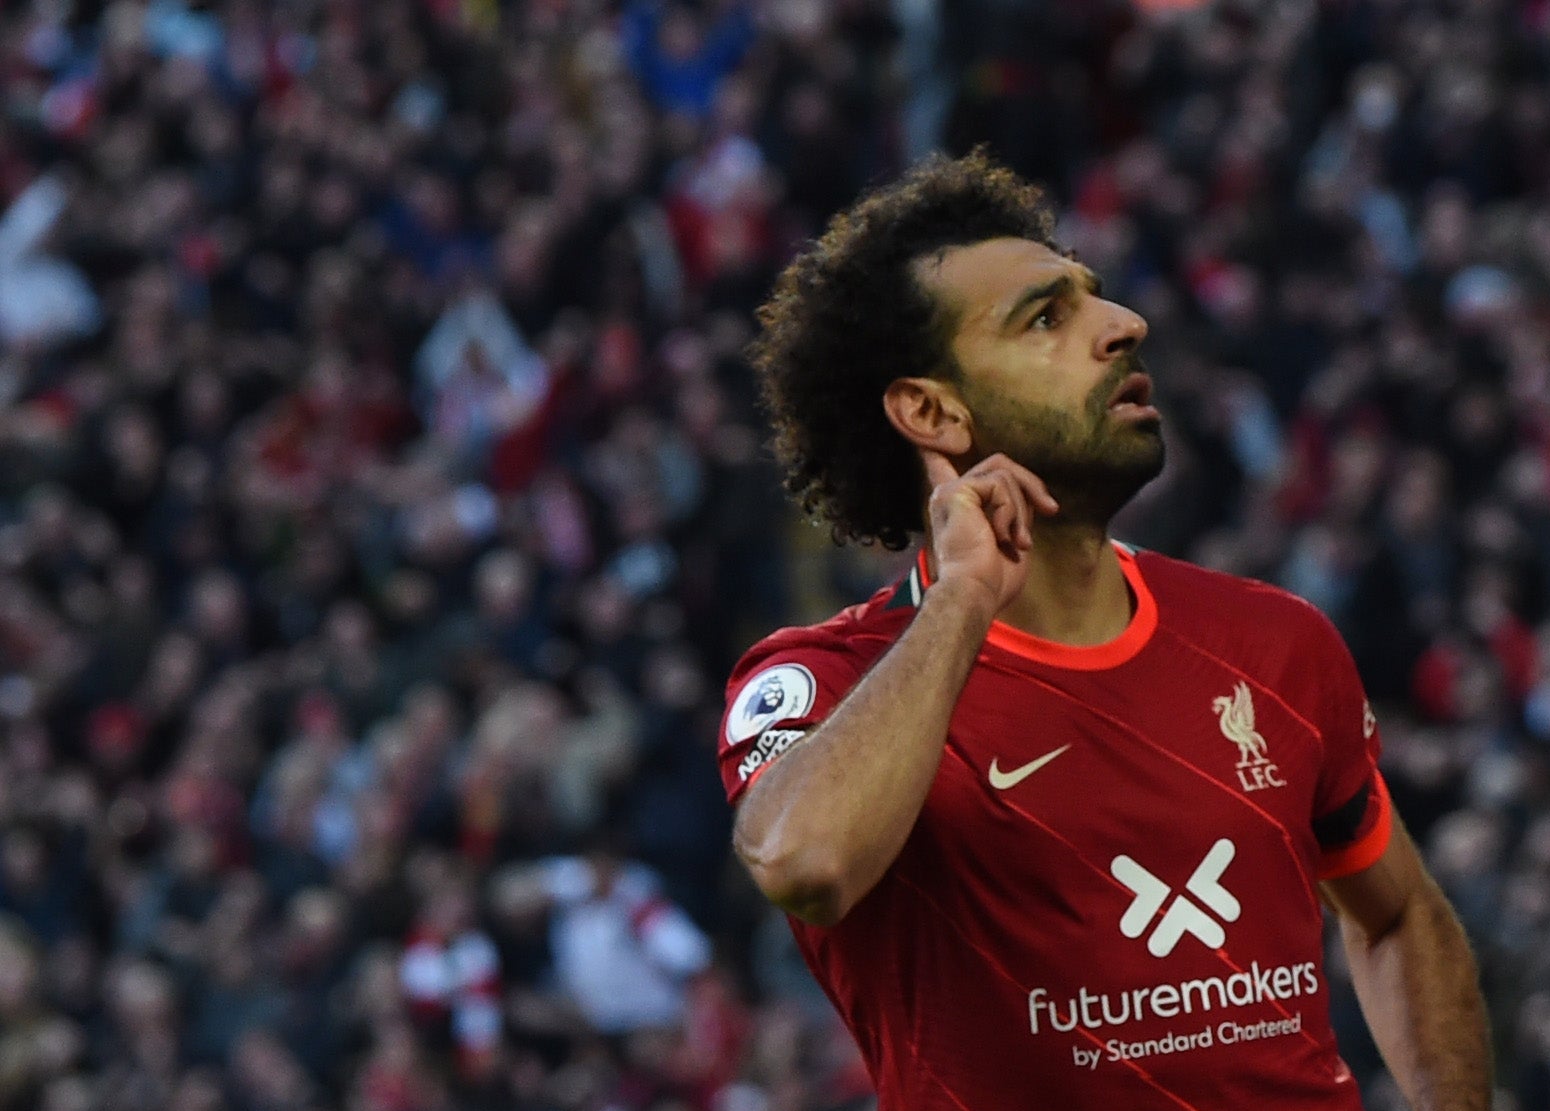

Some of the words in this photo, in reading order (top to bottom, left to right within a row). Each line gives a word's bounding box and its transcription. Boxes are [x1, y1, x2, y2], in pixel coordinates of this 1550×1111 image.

[1028, 961, 1318, 1034] futuremakers
[1073, 1046, 1101, 1071] by
[1106, 1027, 1212, 1061] Standard
[1217, 1012, 1302, 1045] Chartered
